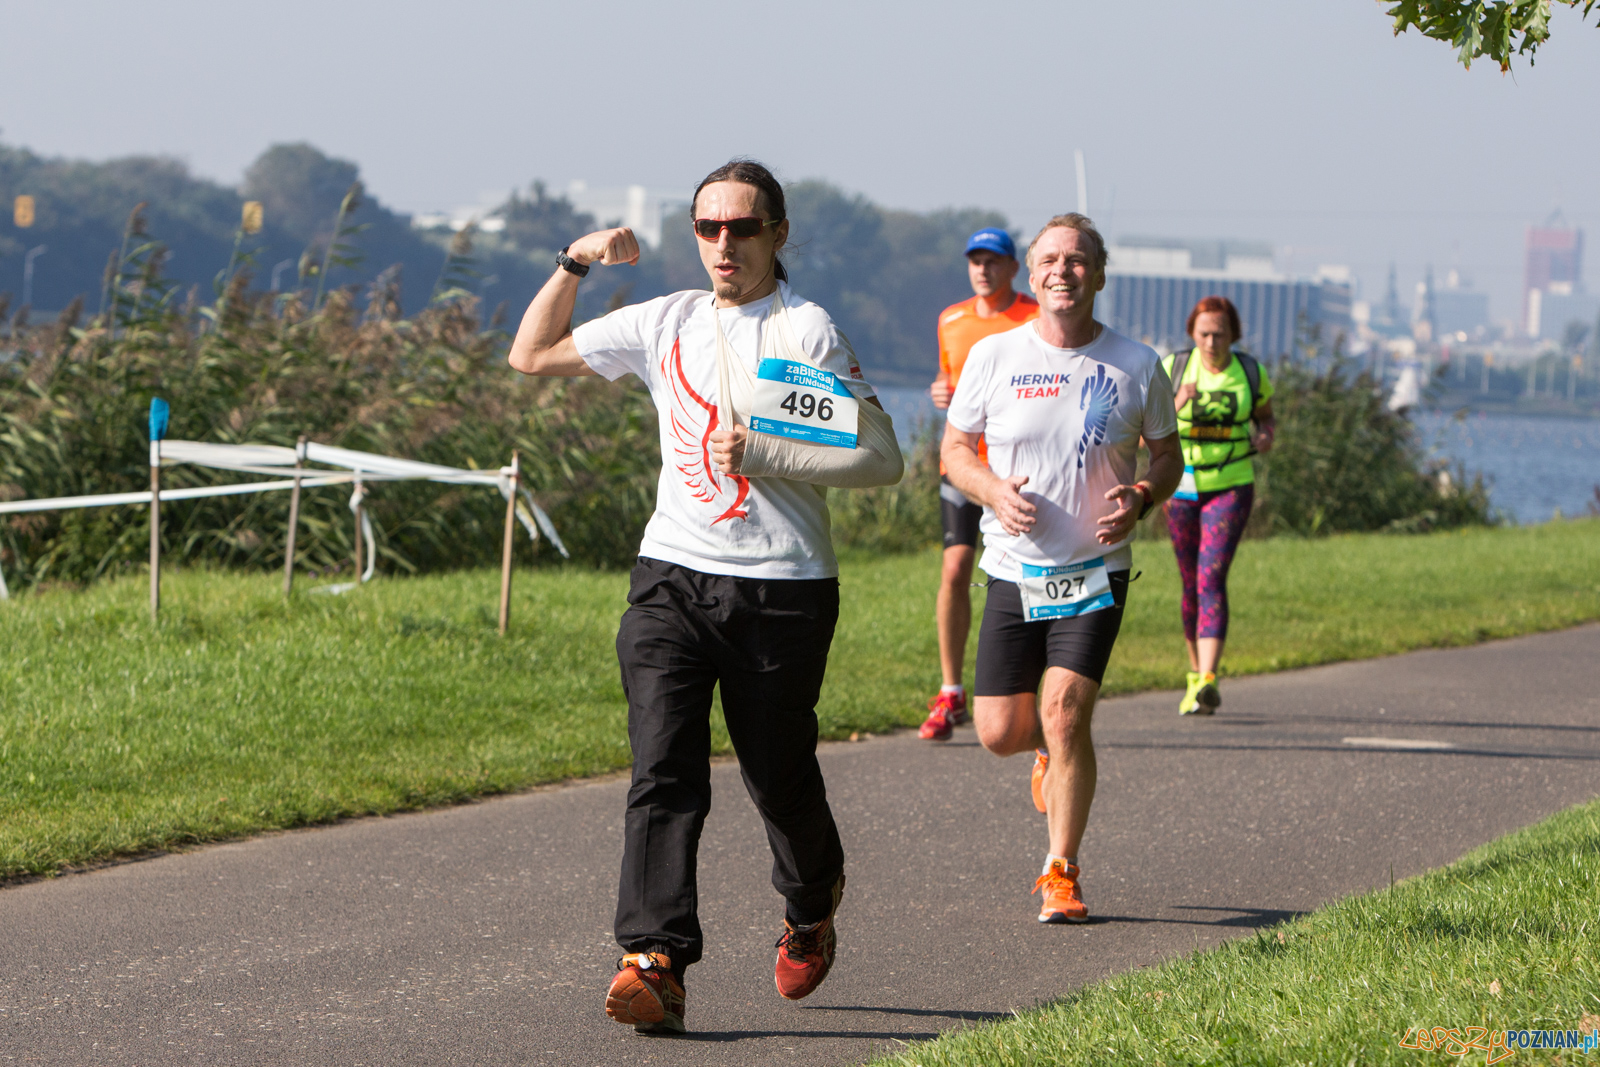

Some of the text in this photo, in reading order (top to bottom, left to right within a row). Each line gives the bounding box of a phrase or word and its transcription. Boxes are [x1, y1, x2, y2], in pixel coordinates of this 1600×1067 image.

[786, 365, 835, 387] zaBIEGaj
[793, 375, 834, 393] FUNdusze
[1010, 373, 1071, 387] HERNIK
[1016, 386, 1060, 399] TEAM
[780, 390, 834, 421] 496
[1045, 575, 1086, 600] 027
